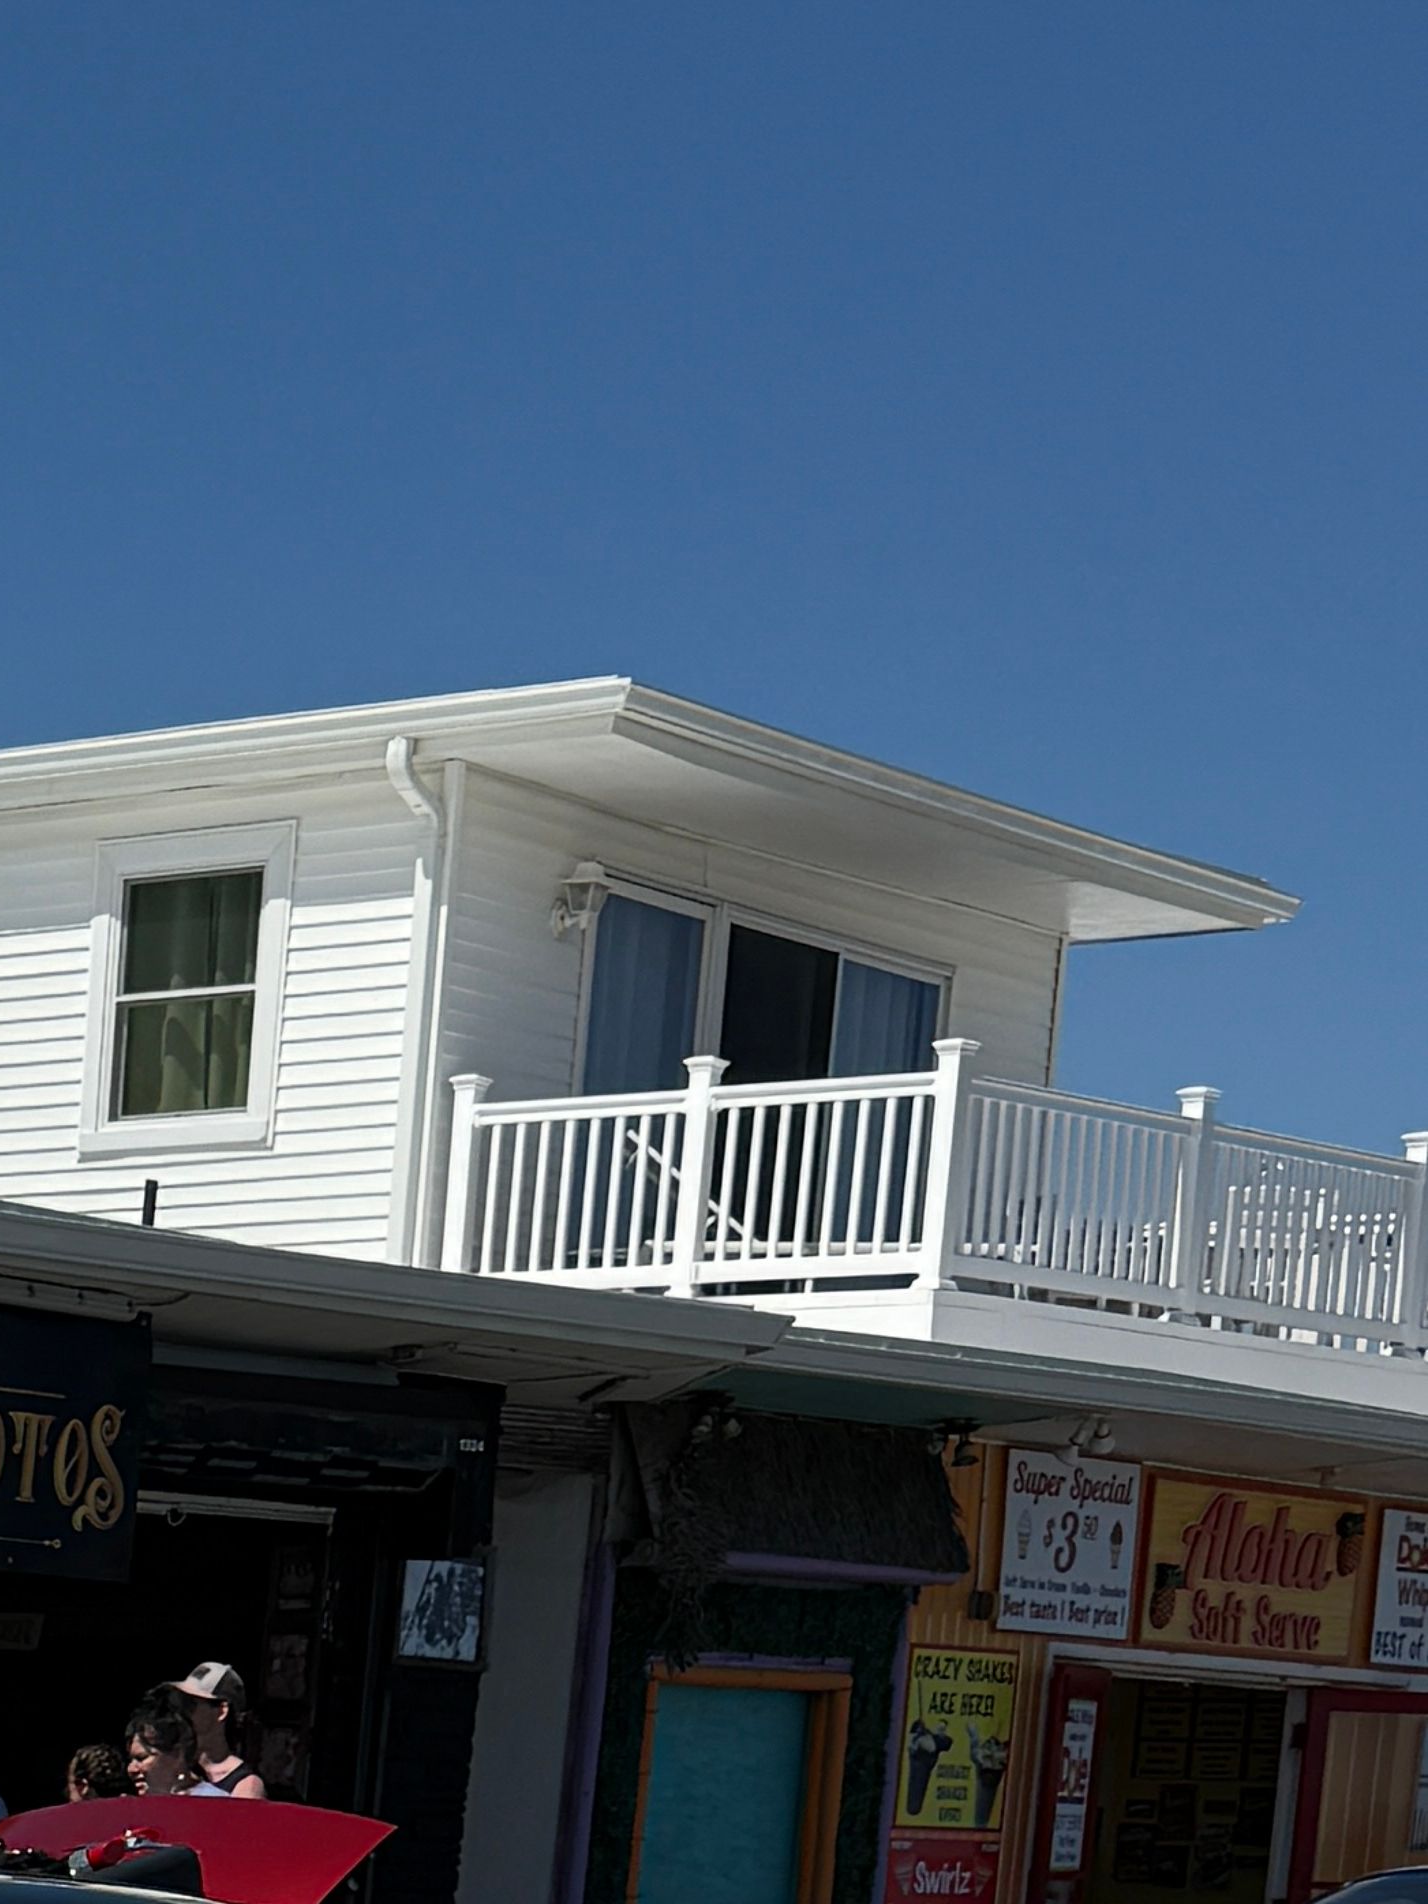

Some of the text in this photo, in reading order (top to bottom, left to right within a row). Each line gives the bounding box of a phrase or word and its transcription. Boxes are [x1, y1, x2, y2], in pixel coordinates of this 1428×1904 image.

[1013, 1461, 1133, 1509] Super Special
[1182, 1493, 1333, 1591] Aloha
[1190, 1589, 1321, 1650] Soft Serve
[1374, 1631, 1407, 1659] BEST
[914, 1655, 1015, 1685] CRAZY SHAKES
[928, 1691, 958, 1714] ARE
[913, 1860, 972, 1894] Swirlz
